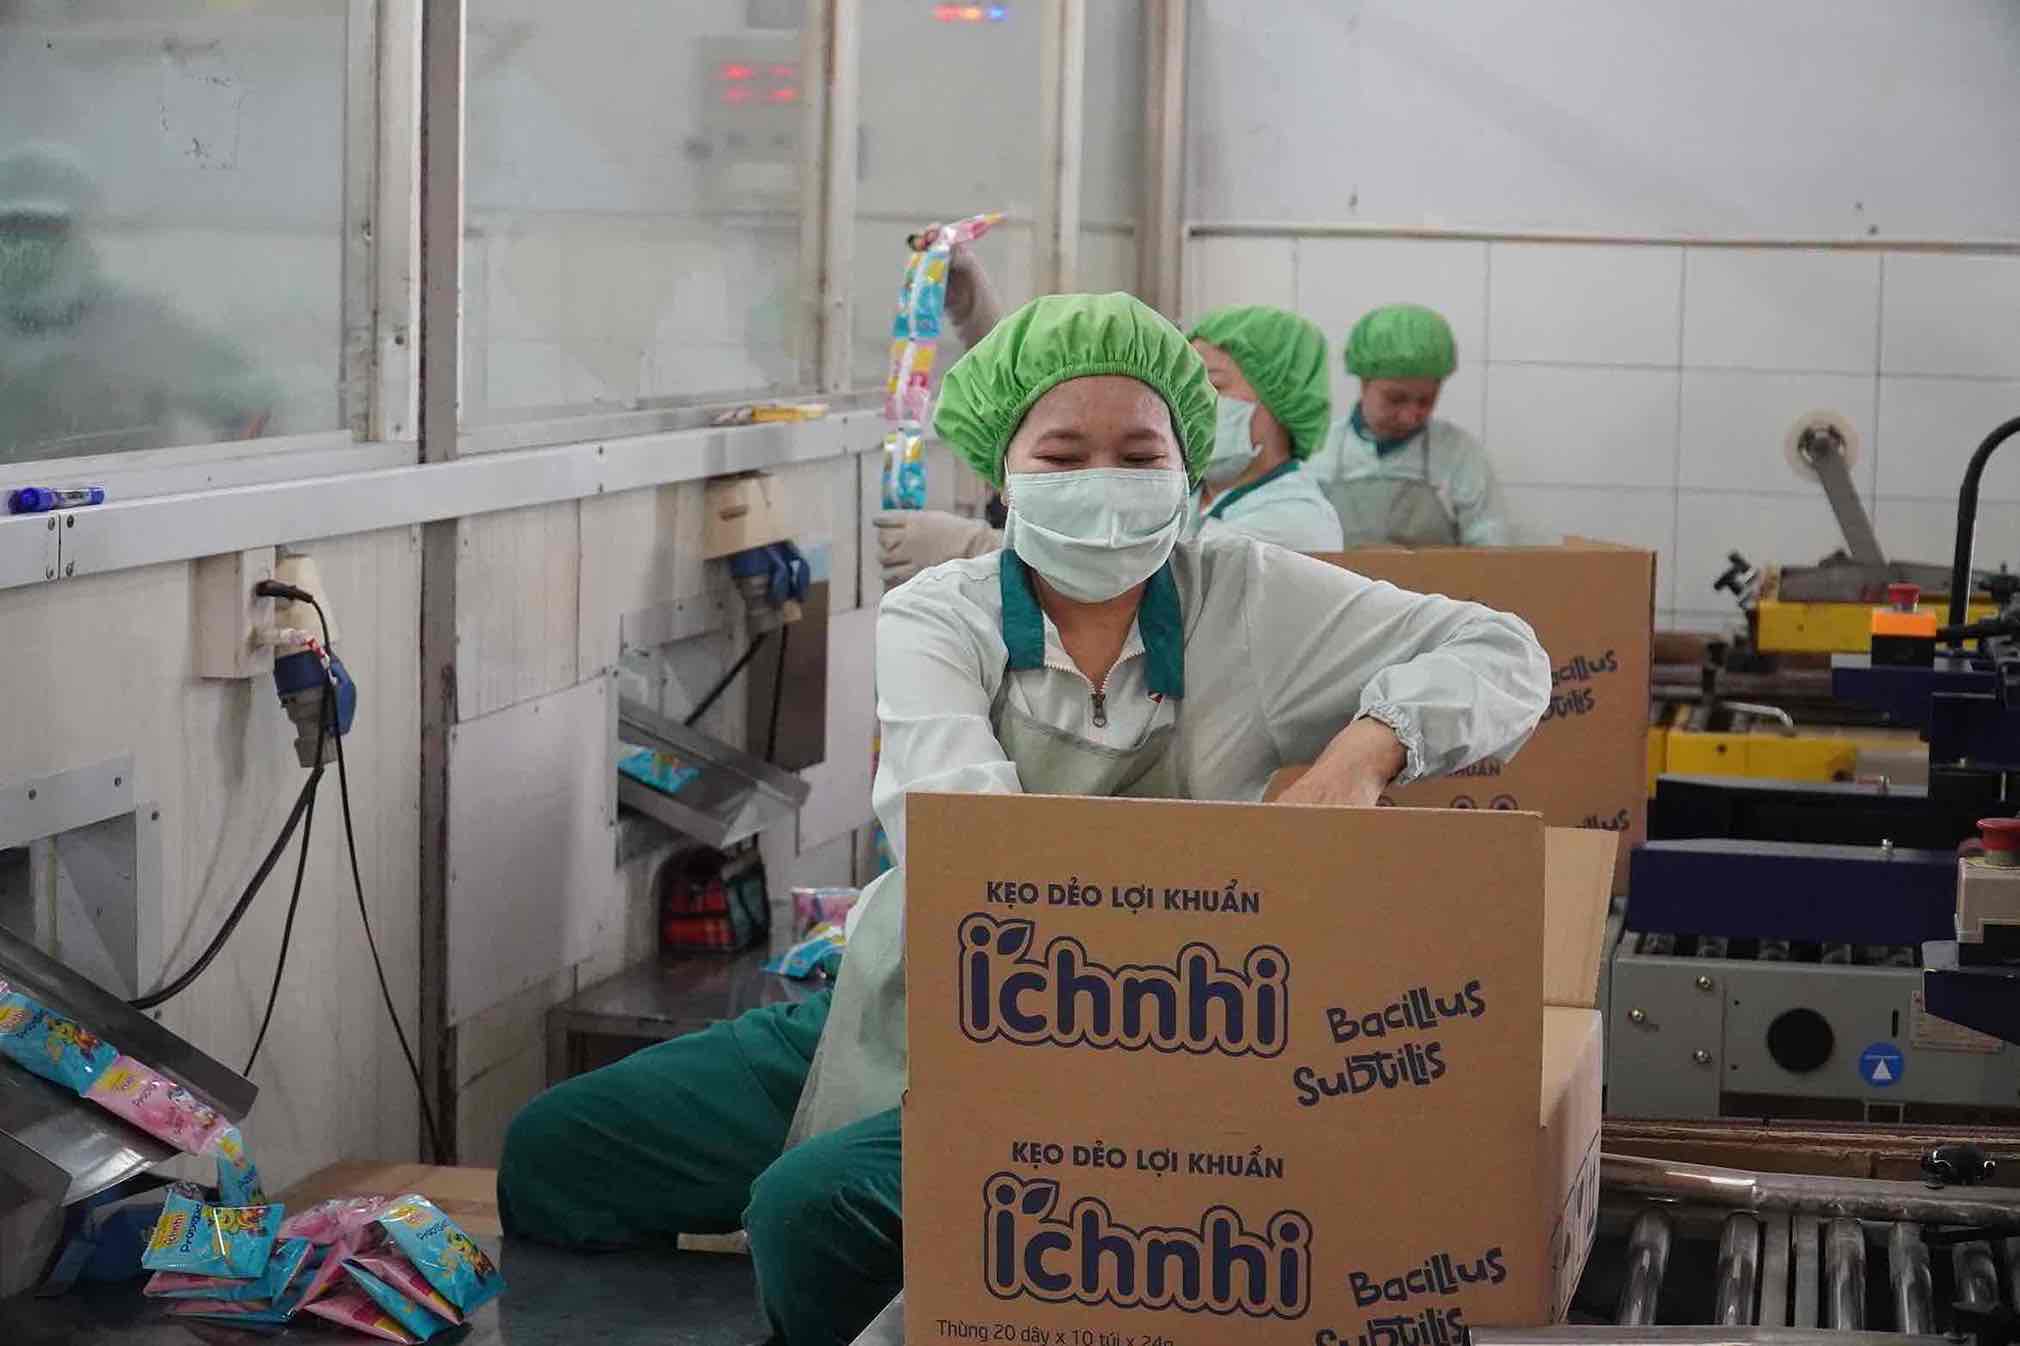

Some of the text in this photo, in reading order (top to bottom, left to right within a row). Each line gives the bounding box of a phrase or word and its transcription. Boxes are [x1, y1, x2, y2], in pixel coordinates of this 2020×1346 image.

[986, 876, 1260, 915] KẸO DẺO LỢI KHUẨN
[1011, 1140, 1285, 1179] KẸO DẺO LỢI KHUẨN
[936, 1319, 989, 1342] Thùng
[993, 1324, 1017, 1341] 20
[1055, 1333, 1066, 1345] x
[1071, 1329, 1094, 1346] 10
